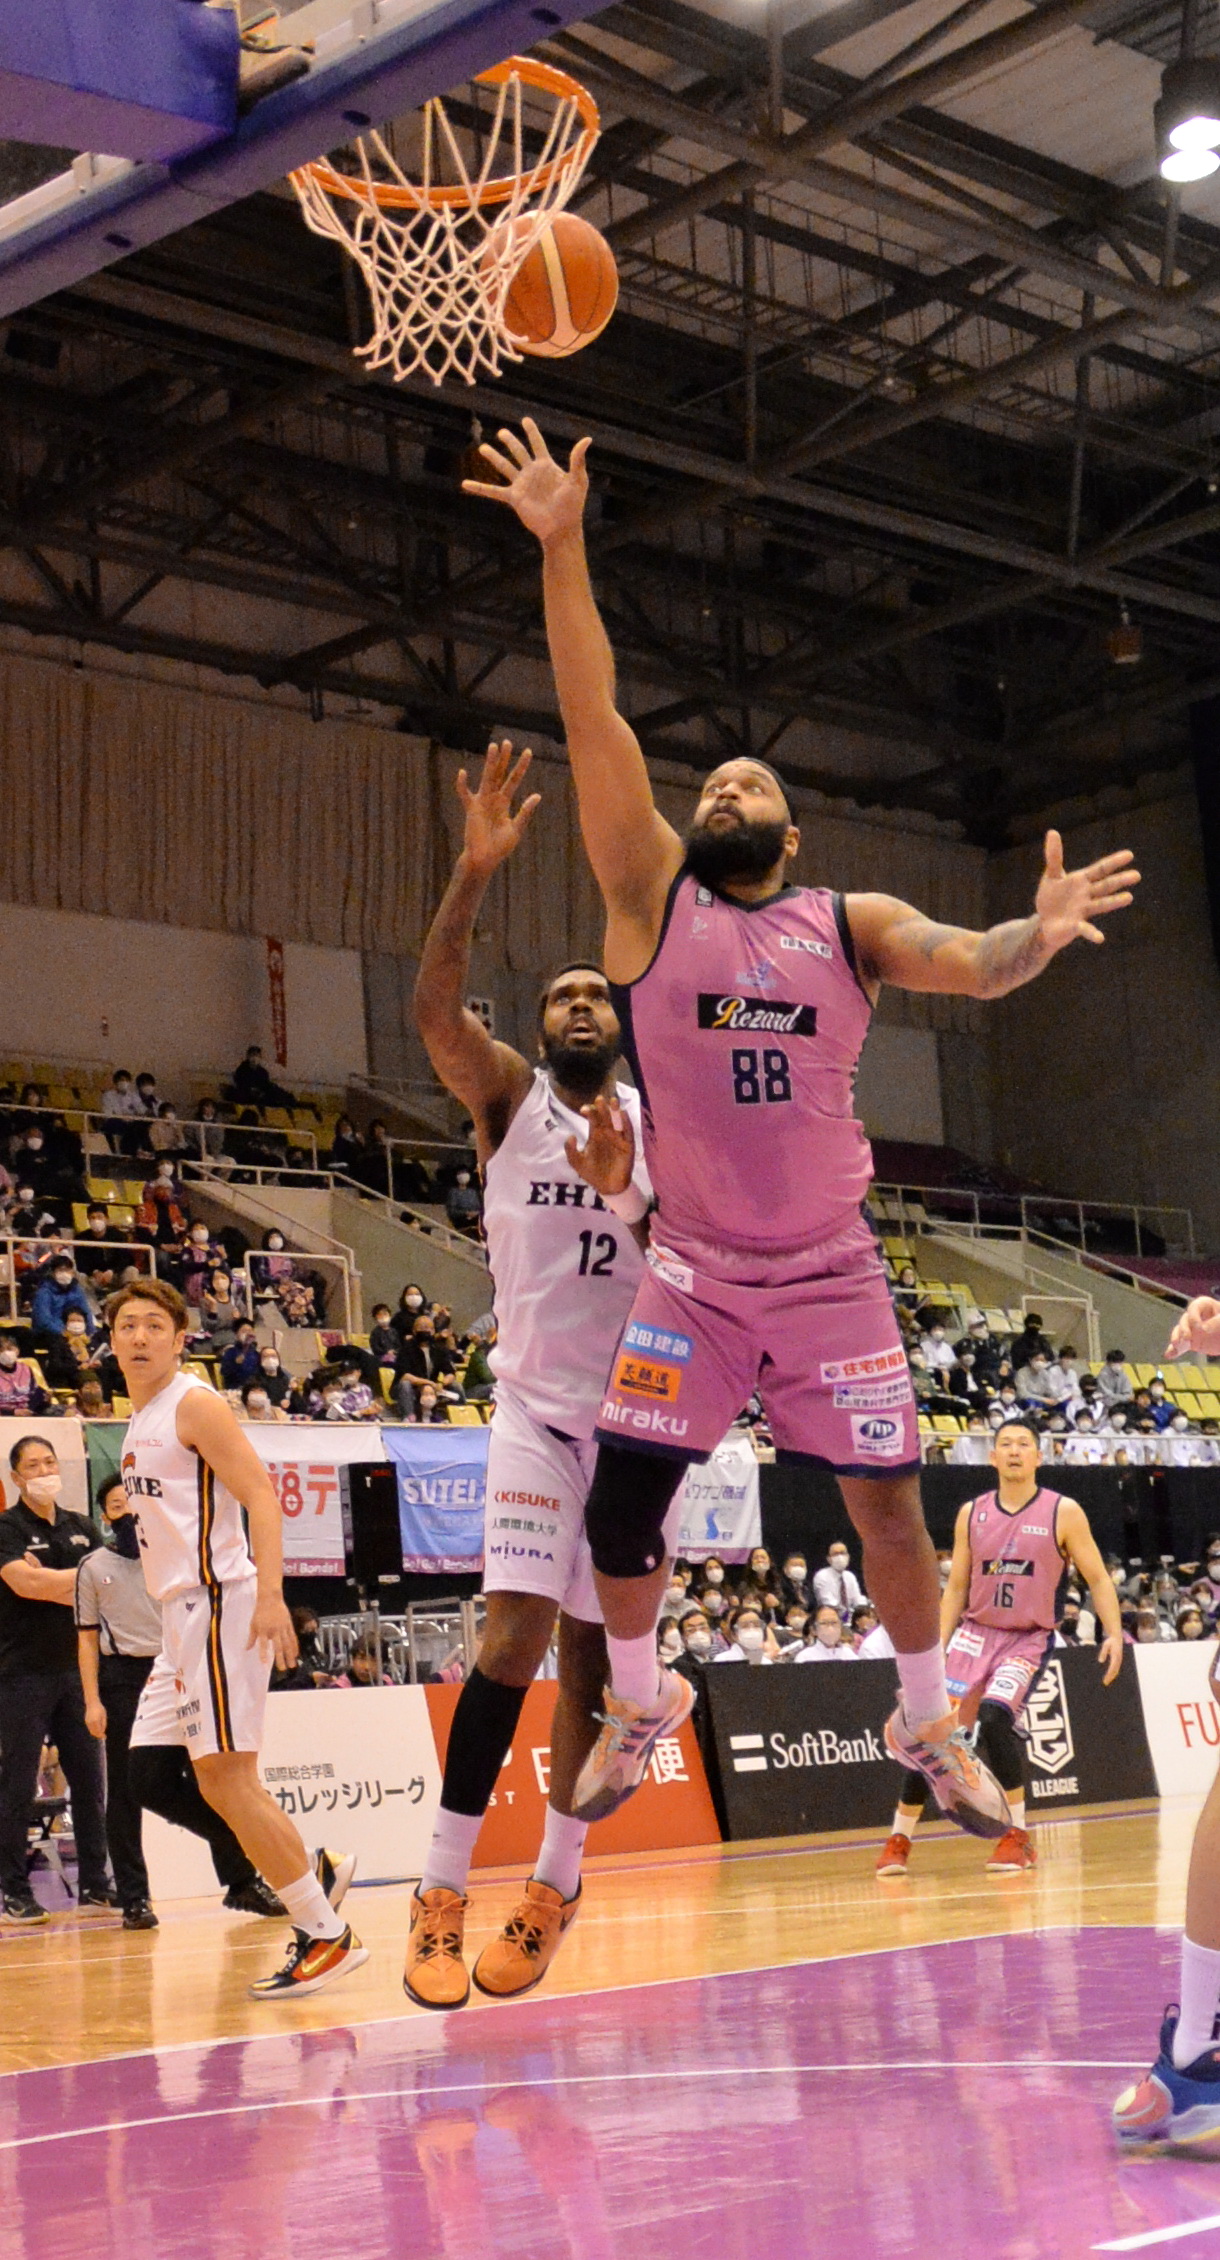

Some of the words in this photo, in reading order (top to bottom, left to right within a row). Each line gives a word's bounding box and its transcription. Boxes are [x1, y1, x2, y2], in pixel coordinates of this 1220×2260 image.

[712, 996, 803, 1032] Rezard
[731, 1048, 792, 1104] 88
[526, 1181, 616, 1214] EHI
[578, 1229, 618, 1276] 12
[602, 1397, 689, 1436] niraku
[993, 1582, 1015, 1608] 16
[769, 1728, 884, 1769] SoftBank
[264, 1763, 336, 1783] 国際総合学園
[1031, 1776, 1080, 1799] B.LEAGUE
[266, 1776, 425, 1815] カレッジリーグ
